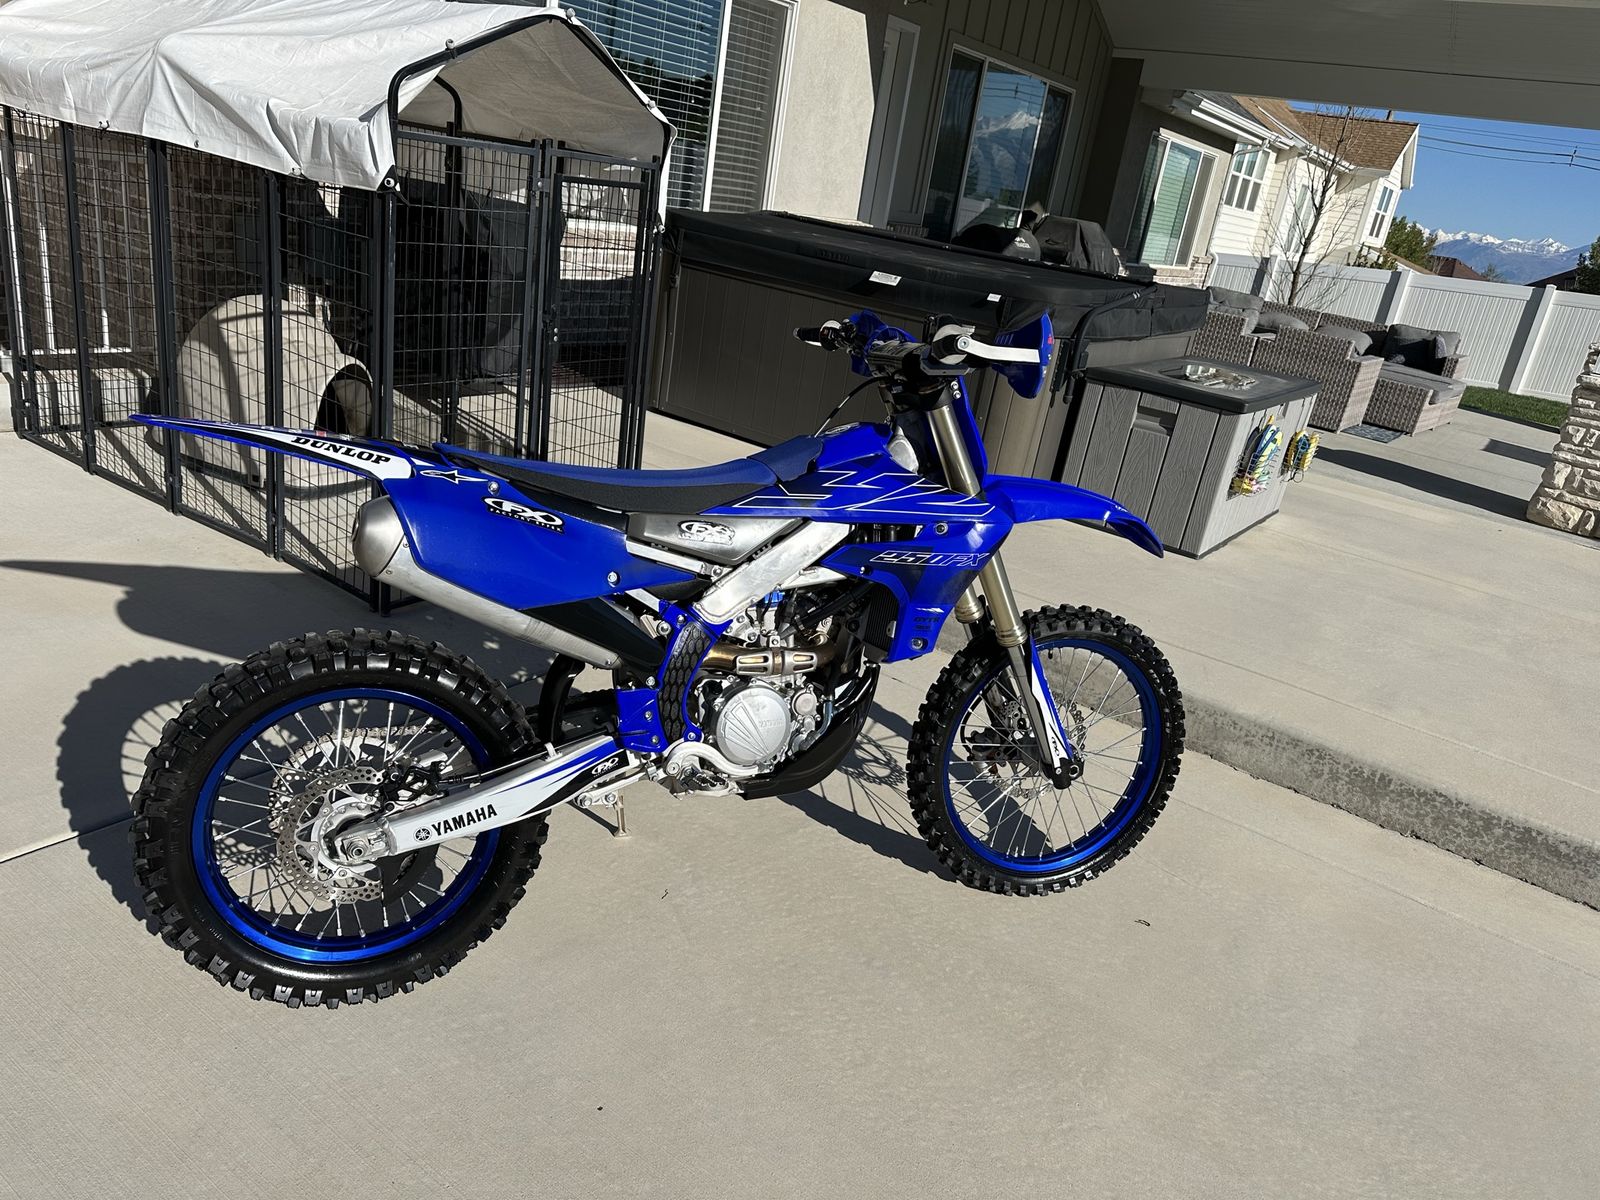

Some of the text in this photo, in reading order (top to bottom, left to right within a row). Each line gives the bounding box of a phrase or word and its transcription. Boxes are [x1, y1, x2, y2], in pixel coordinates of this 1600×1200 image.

[290, 436, 391, 465] DUNLOP
[489, 508, 531, 522] FACTORY
[869, 549, 990, 567] 250FX
[431, 803, 498, 836] YAMAHA
